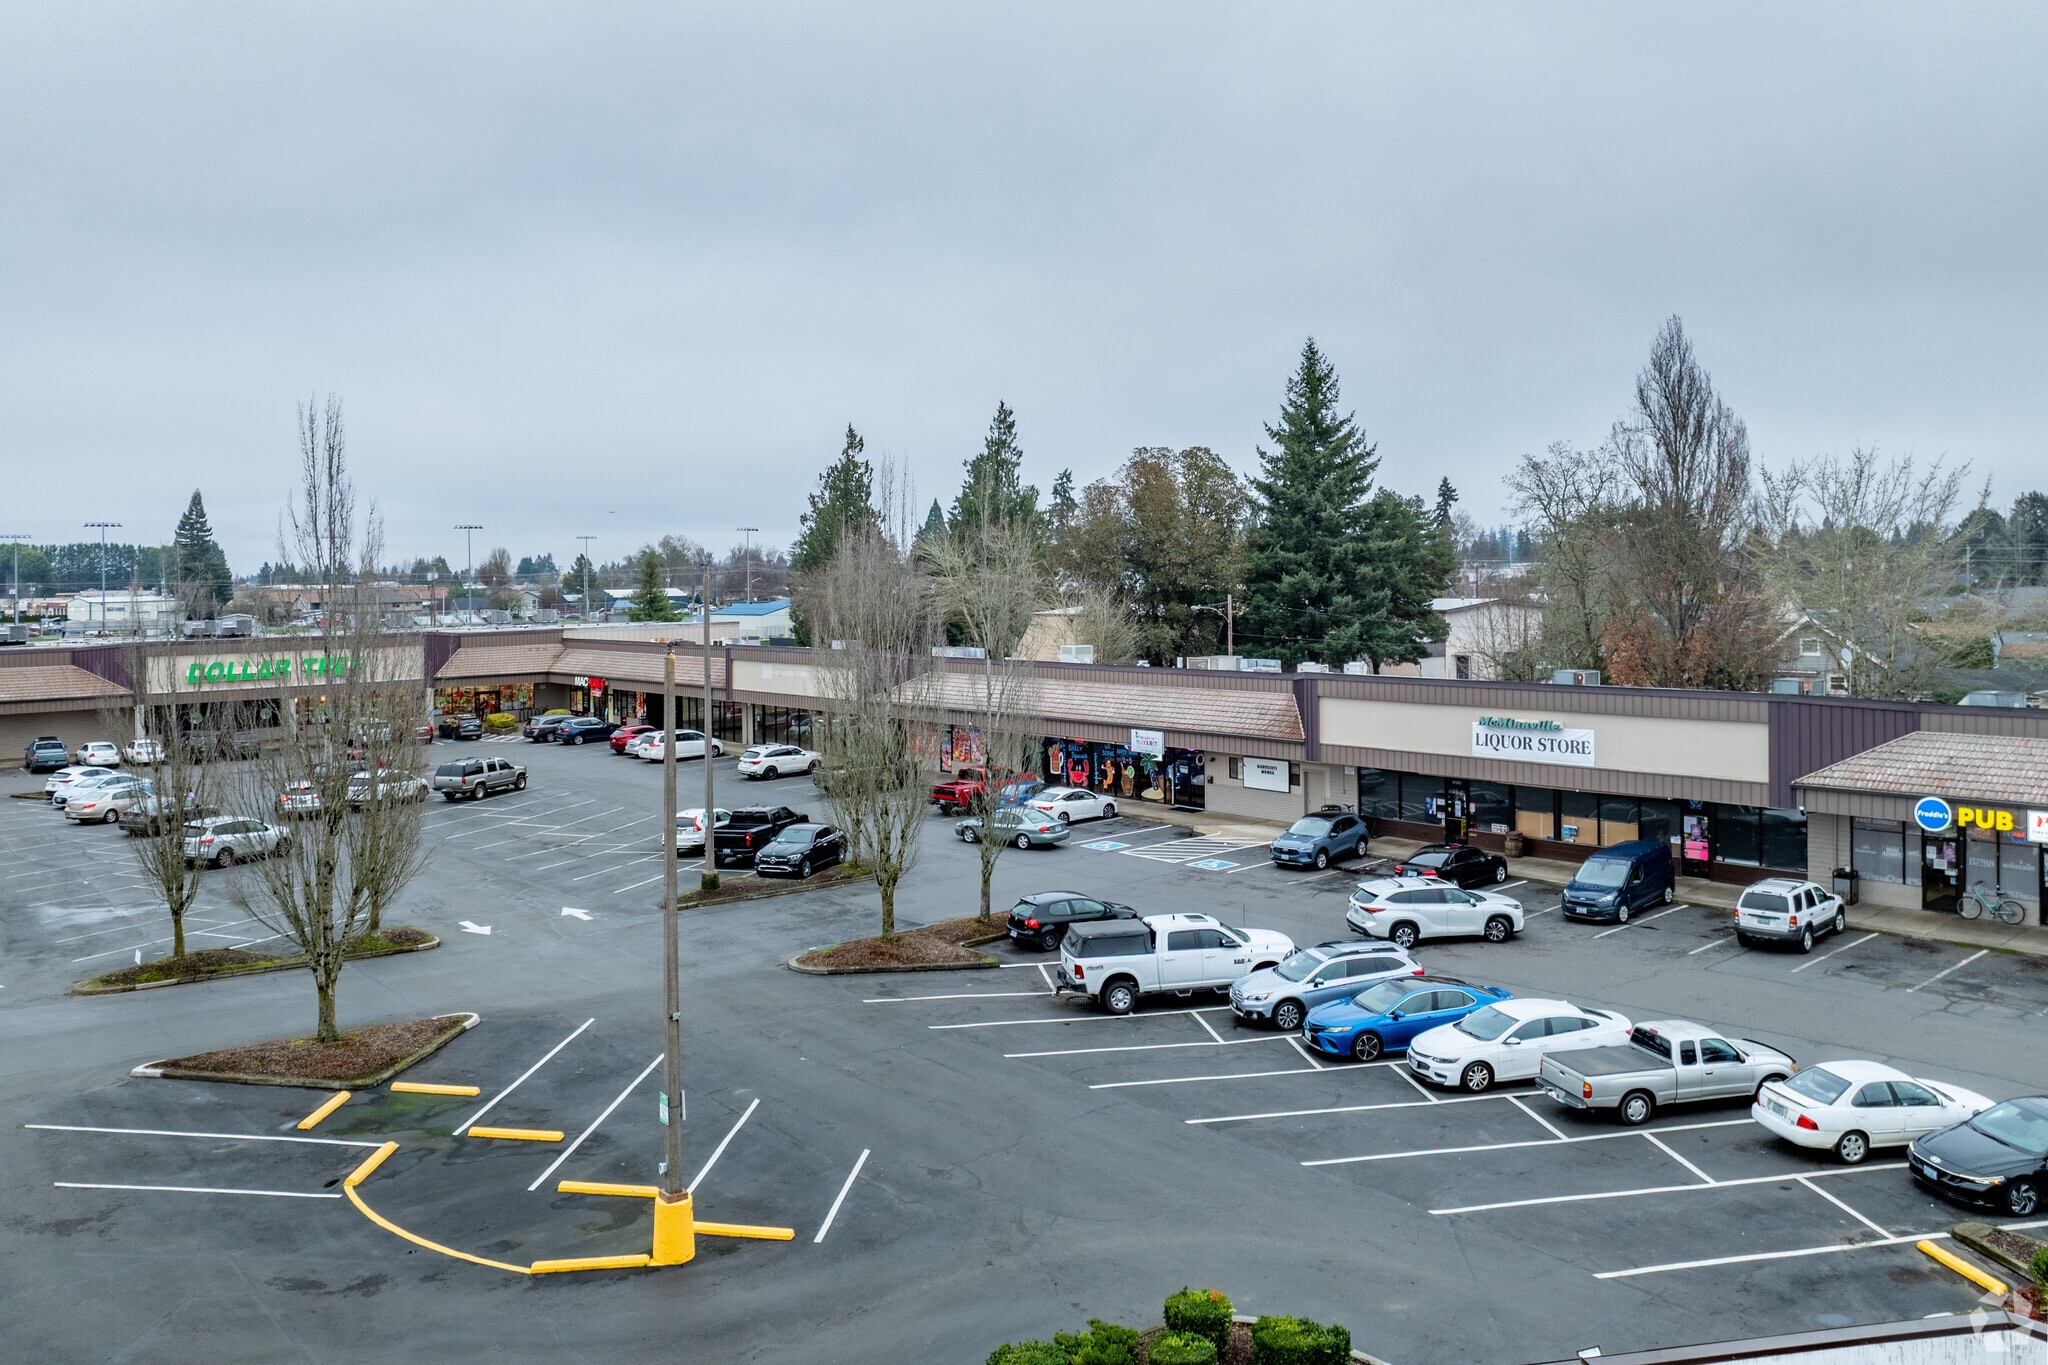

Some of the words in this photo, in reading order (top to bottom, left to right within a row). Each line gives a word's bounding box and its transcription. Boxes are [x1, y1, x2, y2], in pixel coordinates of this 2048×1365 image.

[187, 659, 291, 684] DOLLAR
[1478, 716, 1562, 732] McMinnville
[1475, 732, 1533, 752] LIQUOR
[1537, 737, 1592, 755] STORE
[1917, 809, 1948, 819] Freddie's
[1958, 807, 2014, 831] PUB
